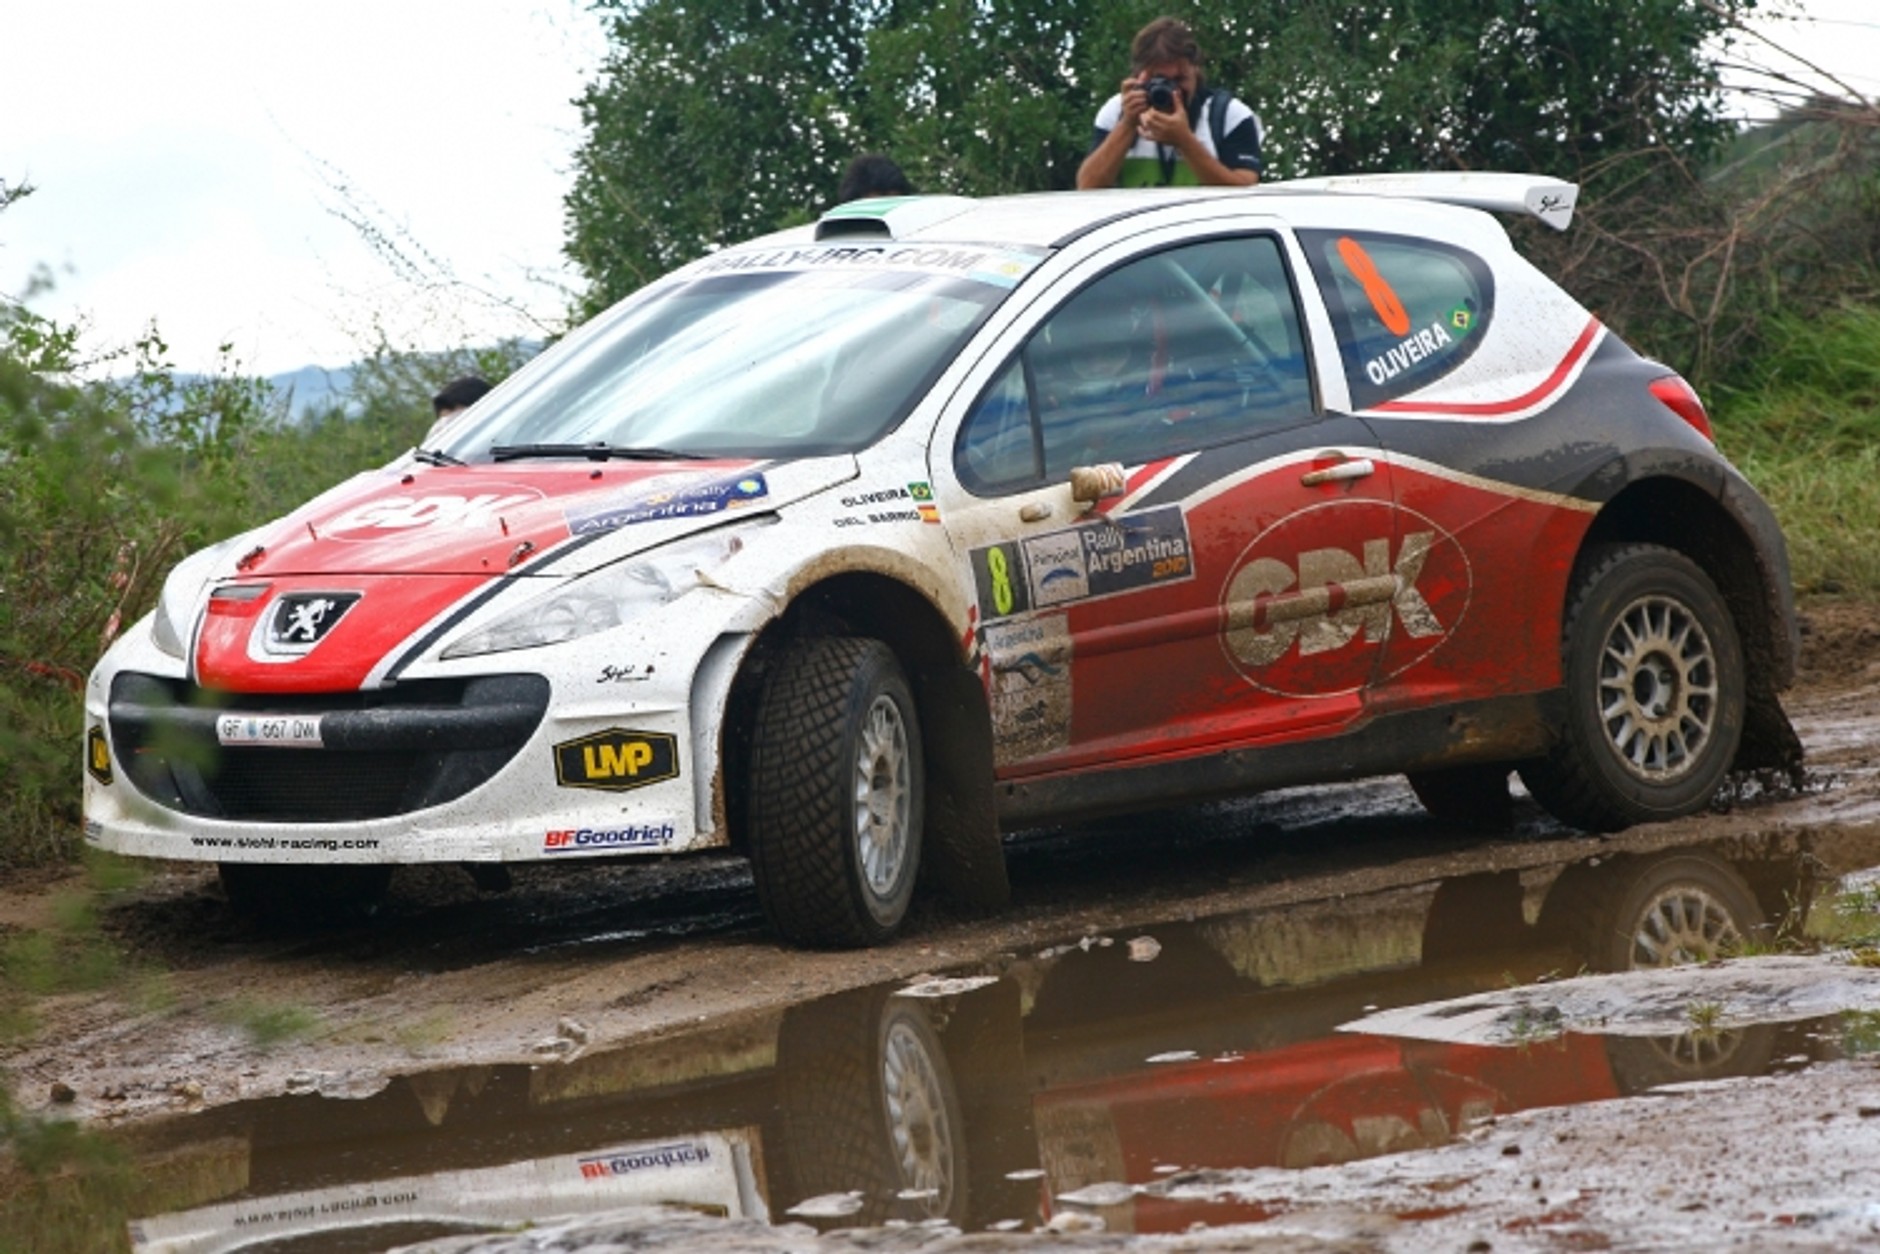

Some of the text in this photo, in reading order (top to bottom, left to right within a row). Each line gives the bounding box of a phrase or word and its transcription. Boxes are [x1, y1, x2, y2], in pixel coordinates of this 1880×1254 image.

[1366, 321, 1452, 386] OLIVEIRA
[841, 487, 910, 508] OLIVEIRA
[1083, 526, 1126, 552] Rally
[1088, 537, 1185, 573] Argentina
[1152, 556, 1188, 578] 2010
[987, 546, 1013, 615] 8
[1225, 530, 1445, 666] GDK
[222, 719, 242, 738] GF
[262, 719, 288, 739] 667
[583, 741, 653, 779] LMP
[544, 824, 674, 847] BFGoodrich
